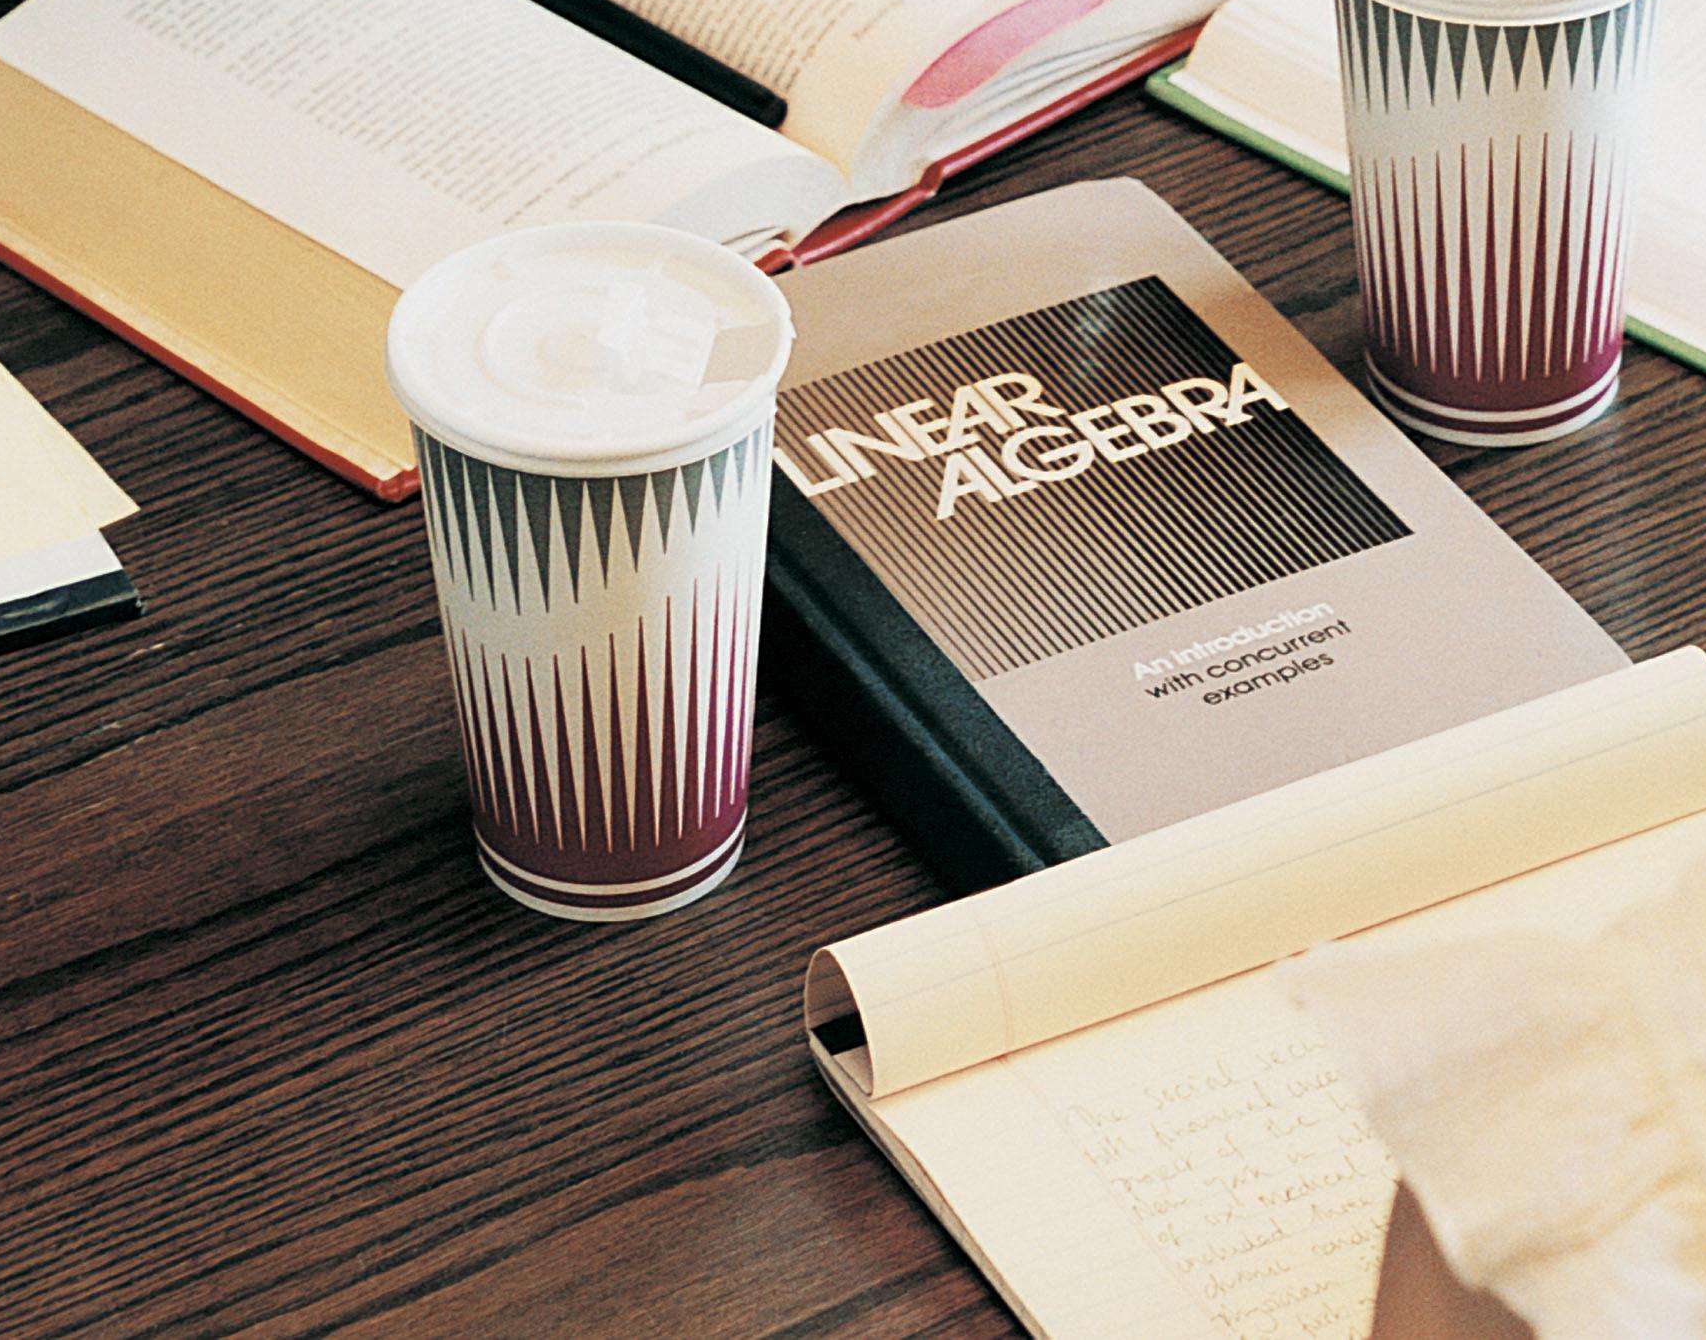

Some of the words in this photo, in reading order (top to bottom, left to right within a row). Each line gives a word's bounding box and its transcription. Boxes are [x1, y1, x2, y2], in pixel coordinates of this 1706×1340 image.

[773, 371, 1066, 498] LINEAR
[936, 362, 1291, 521] ALGEBRA
[1132, 654, 1175, 681] An
[1145, 671, 1205, 700] with
[1206, 618, 1353, 679] concurrent
[1202, 649, 1336, 707] examples
